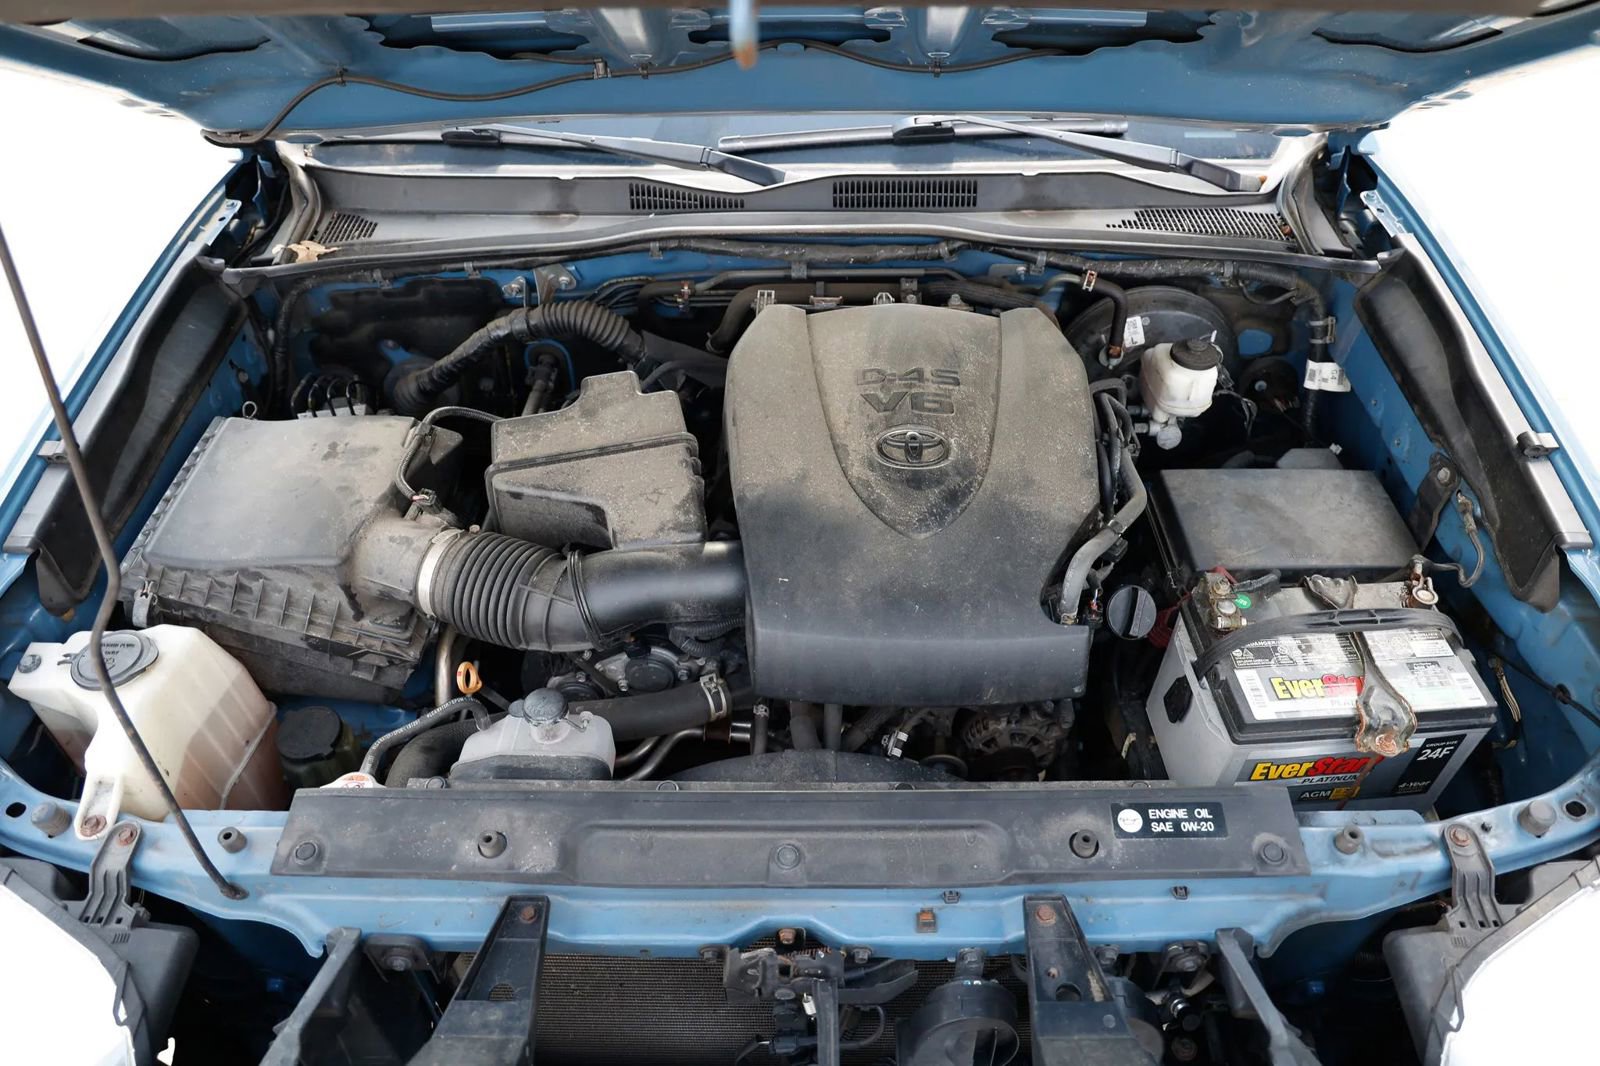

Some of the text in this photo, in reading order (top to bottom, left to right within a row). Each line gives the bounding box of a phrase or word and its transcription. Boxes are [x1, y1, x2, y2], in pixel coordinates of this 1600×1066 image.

[860, 391, 955, 414] V6
[1416, 746, 1454, 761] 24F
[1250, 755, 1385, 781] EverStar
[1301, 774, 1358, 785] PLATINUM
[1300, 788, 1331, 799] AGM
[1148, 808, 1213, 819] ENGINE OIL
[1151, 821, 1174, 833] SAE
[1180, 821, 1215, 832] 0W-20
